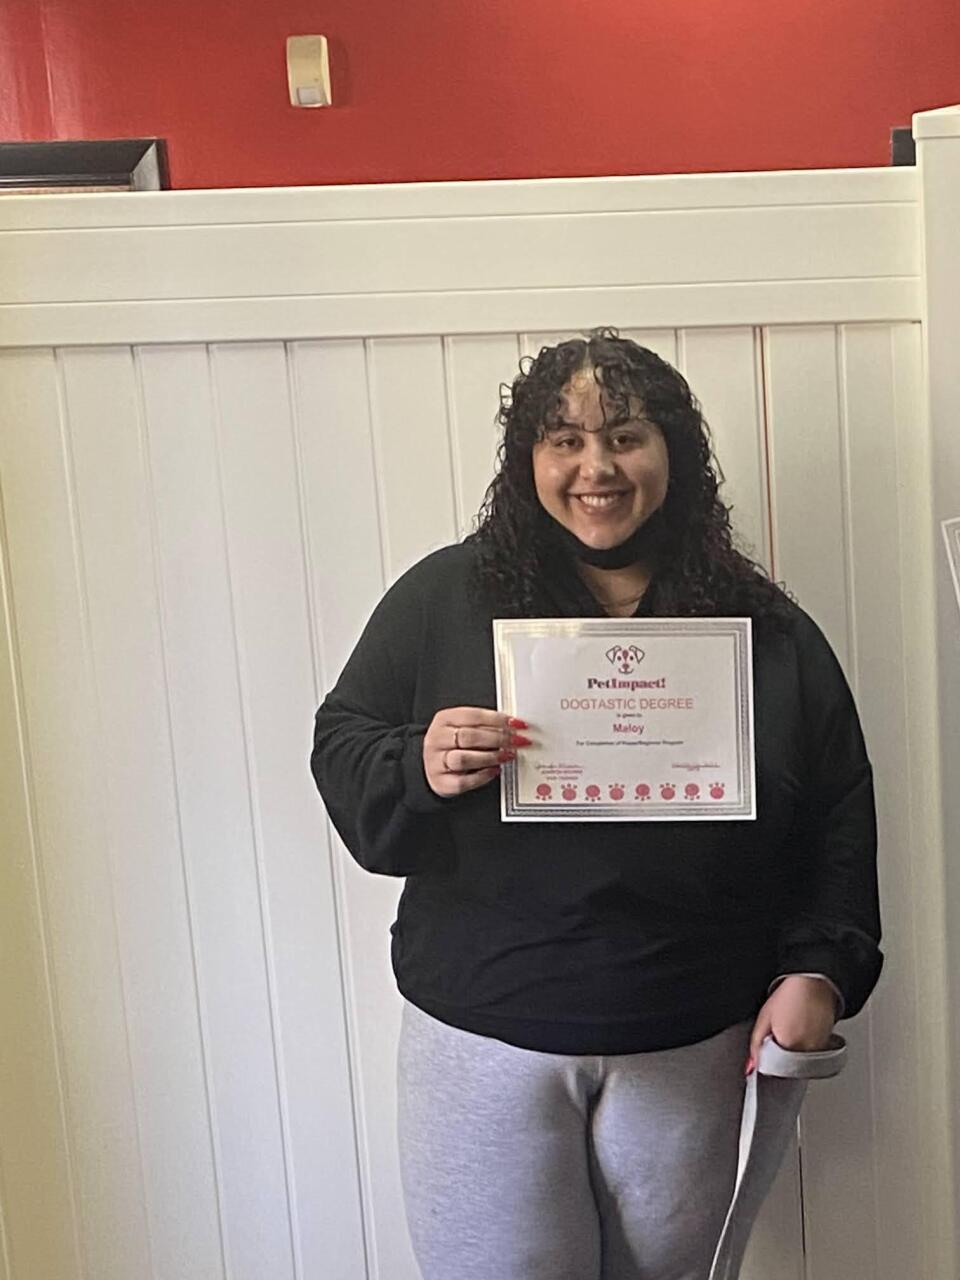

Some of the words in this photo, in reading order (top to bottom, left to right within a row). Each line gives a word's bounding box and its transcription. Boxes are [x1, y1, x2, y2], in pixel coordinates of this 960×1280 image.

[587, 677, 667, 692] PetImpact!
[560, 698, 637, 710] DOGTASTIC
[640, 697, 694, 710] DEGREE
[612, 723, 645, 735] Maloy
